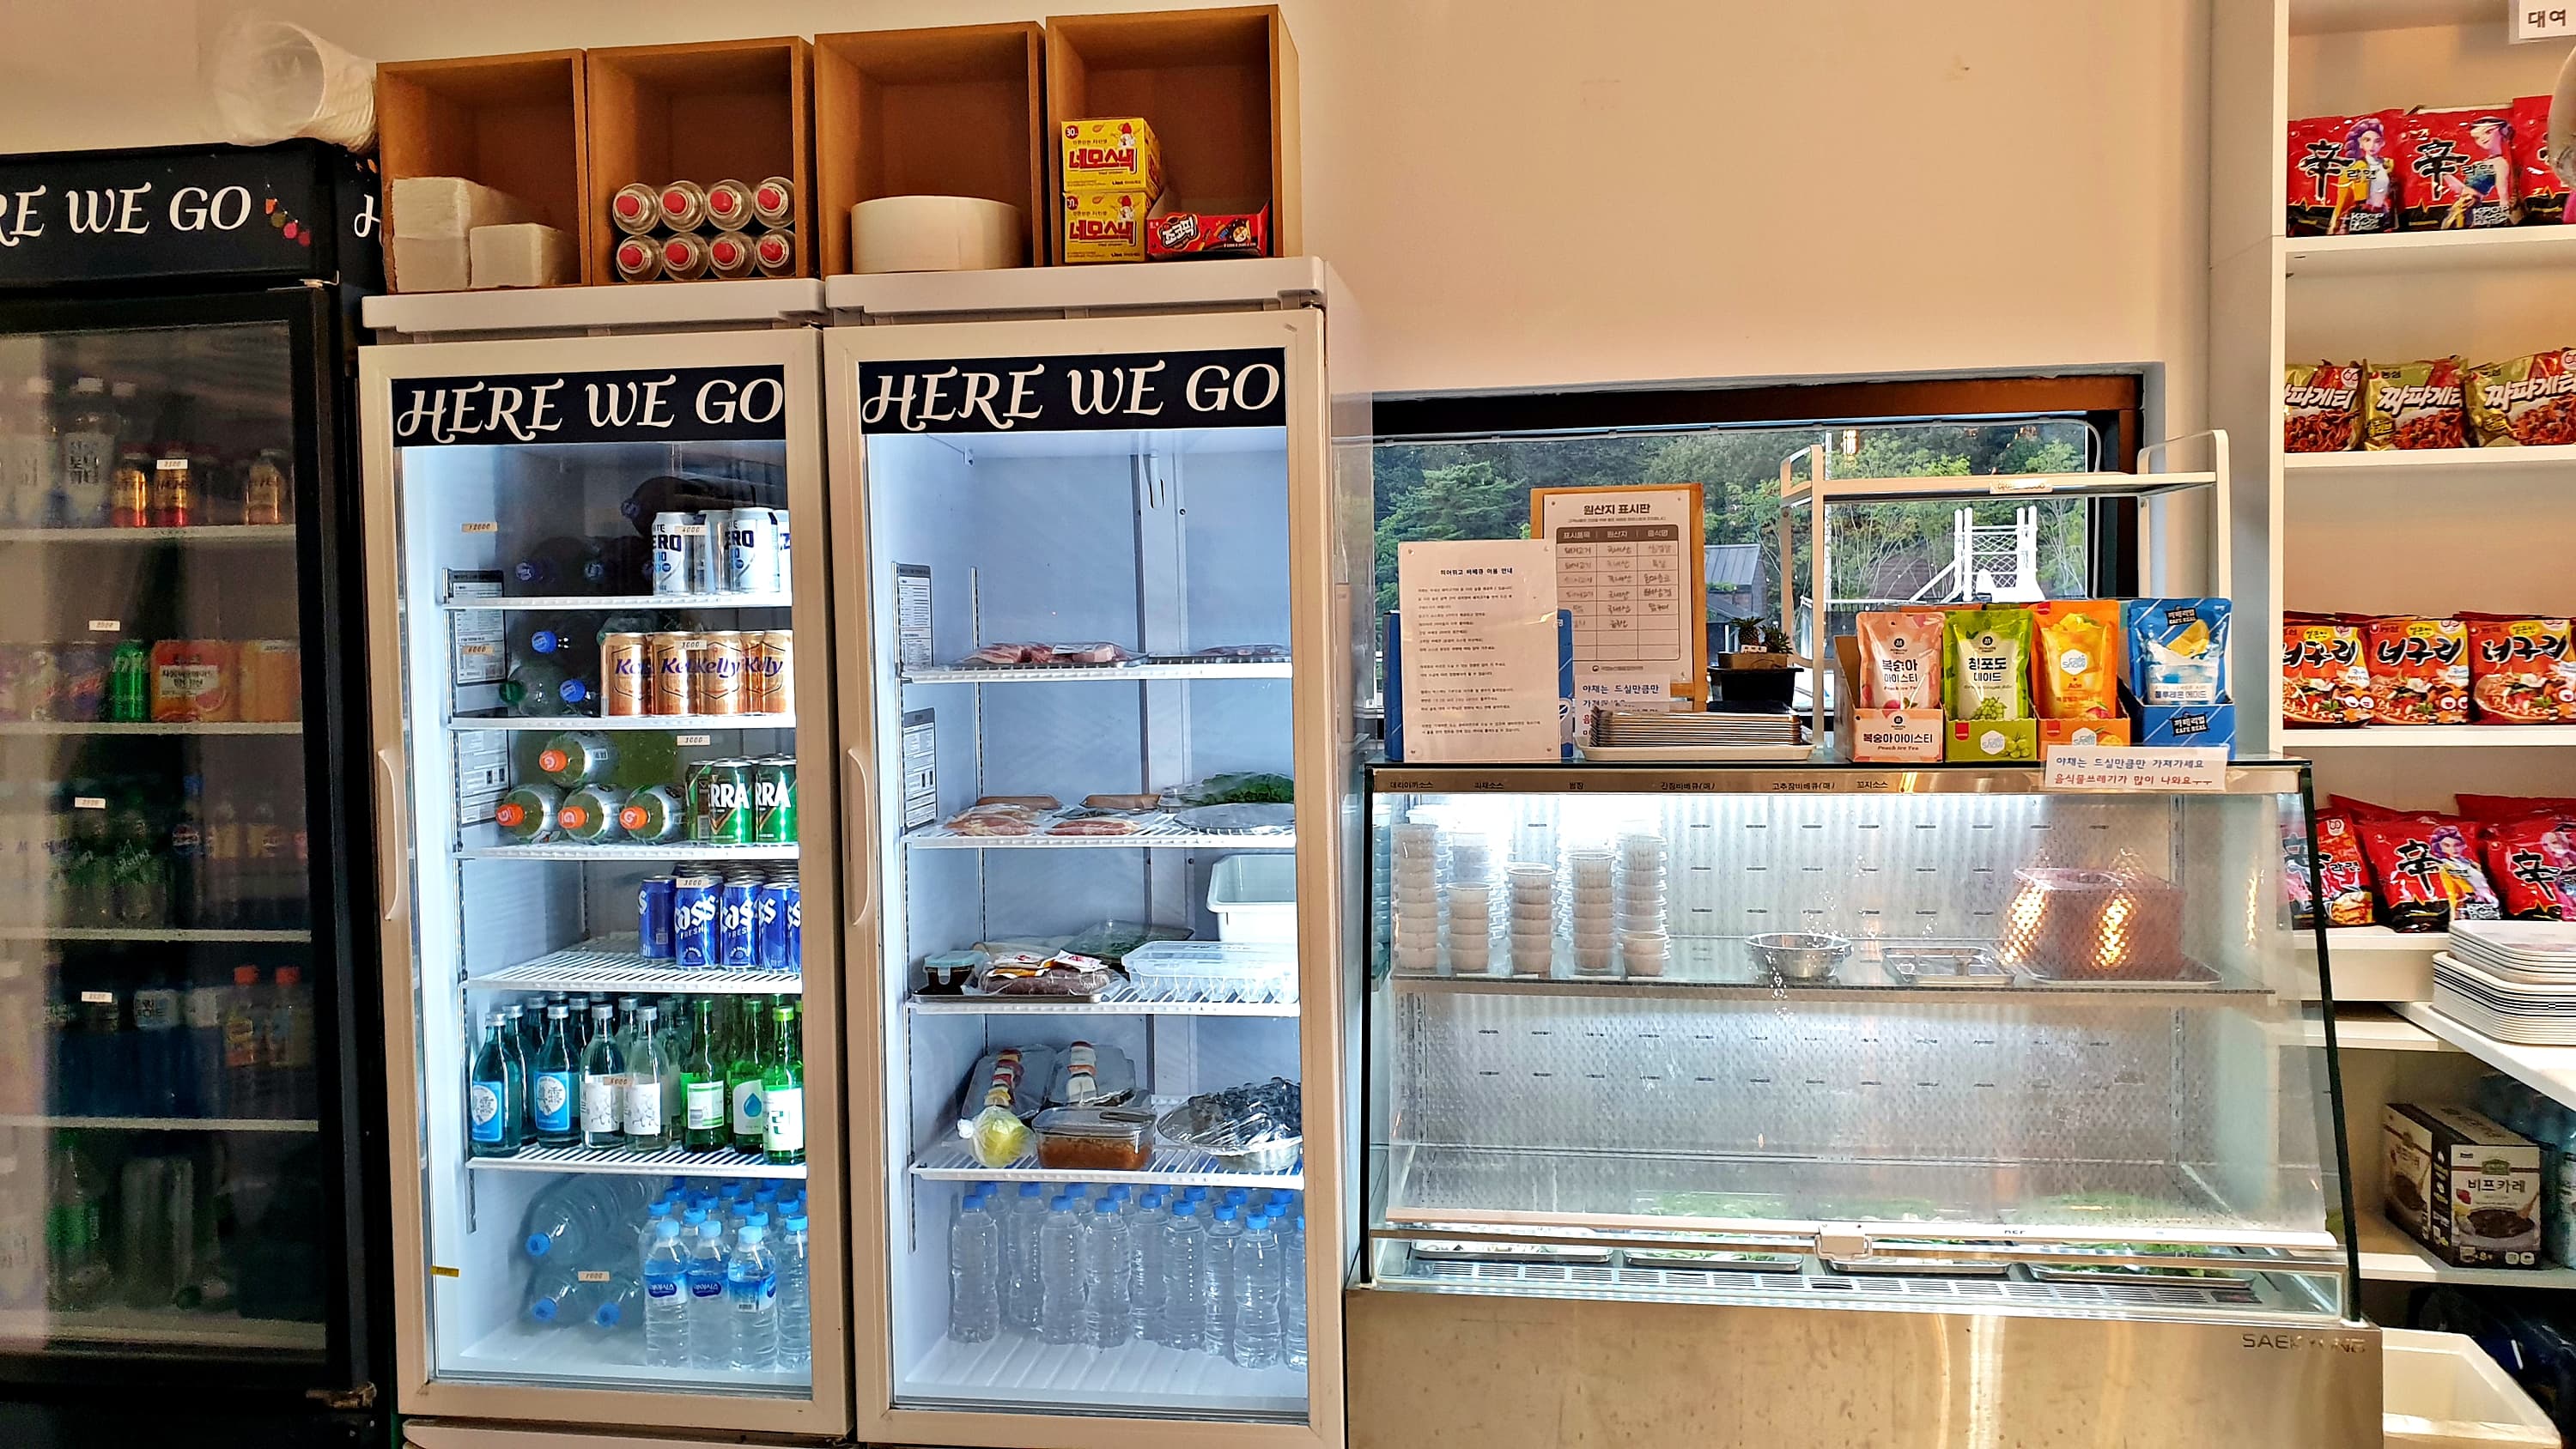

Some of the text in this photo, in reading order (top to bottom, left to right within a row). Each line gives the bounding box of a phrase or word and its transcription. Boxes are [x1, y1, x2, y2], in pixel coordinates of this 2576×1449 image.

[2528, 9, 2566, 27] 대여
[2299, 138, 2355, 201] 辛
[2413, 137, 2470, 201] 辛
[65, 181, 152, 234] WE
[169, 185, 252, 232] GO
[862, 359, 1280, 431] HERE WE GO
[397, 374, 784, 443] HERE WE GO
[1583, 503, 1650, 516] 원산지 표시판
[2378, 637, 2463, 665] 너구리
[2482, 635, 2569, 662] 너구리
[1882, 658, 1918, 672] 복숭아
[1968, 657, 2007, 670] 청포도
[1884, 673, 1918, 683] 아이스티
[1583, 684, 1659, 694] 야채는 드실만큼만
[1862, 733, 1934, 743] 복숭아 아이스티
[2057, 757, 2087, 768] 야채는
[2093, 758, 2146, 769] 드실만큼만
[1856, 780, 1889, 790] 꼬지소스
[2054, 773, 2128, 785] 음식물쓰레기가
[2133, 775, 2154, 785] 많이
[2394, 839, 2444, 900] 辛
[2468, 1179, 2526, 1193] 비프카레
